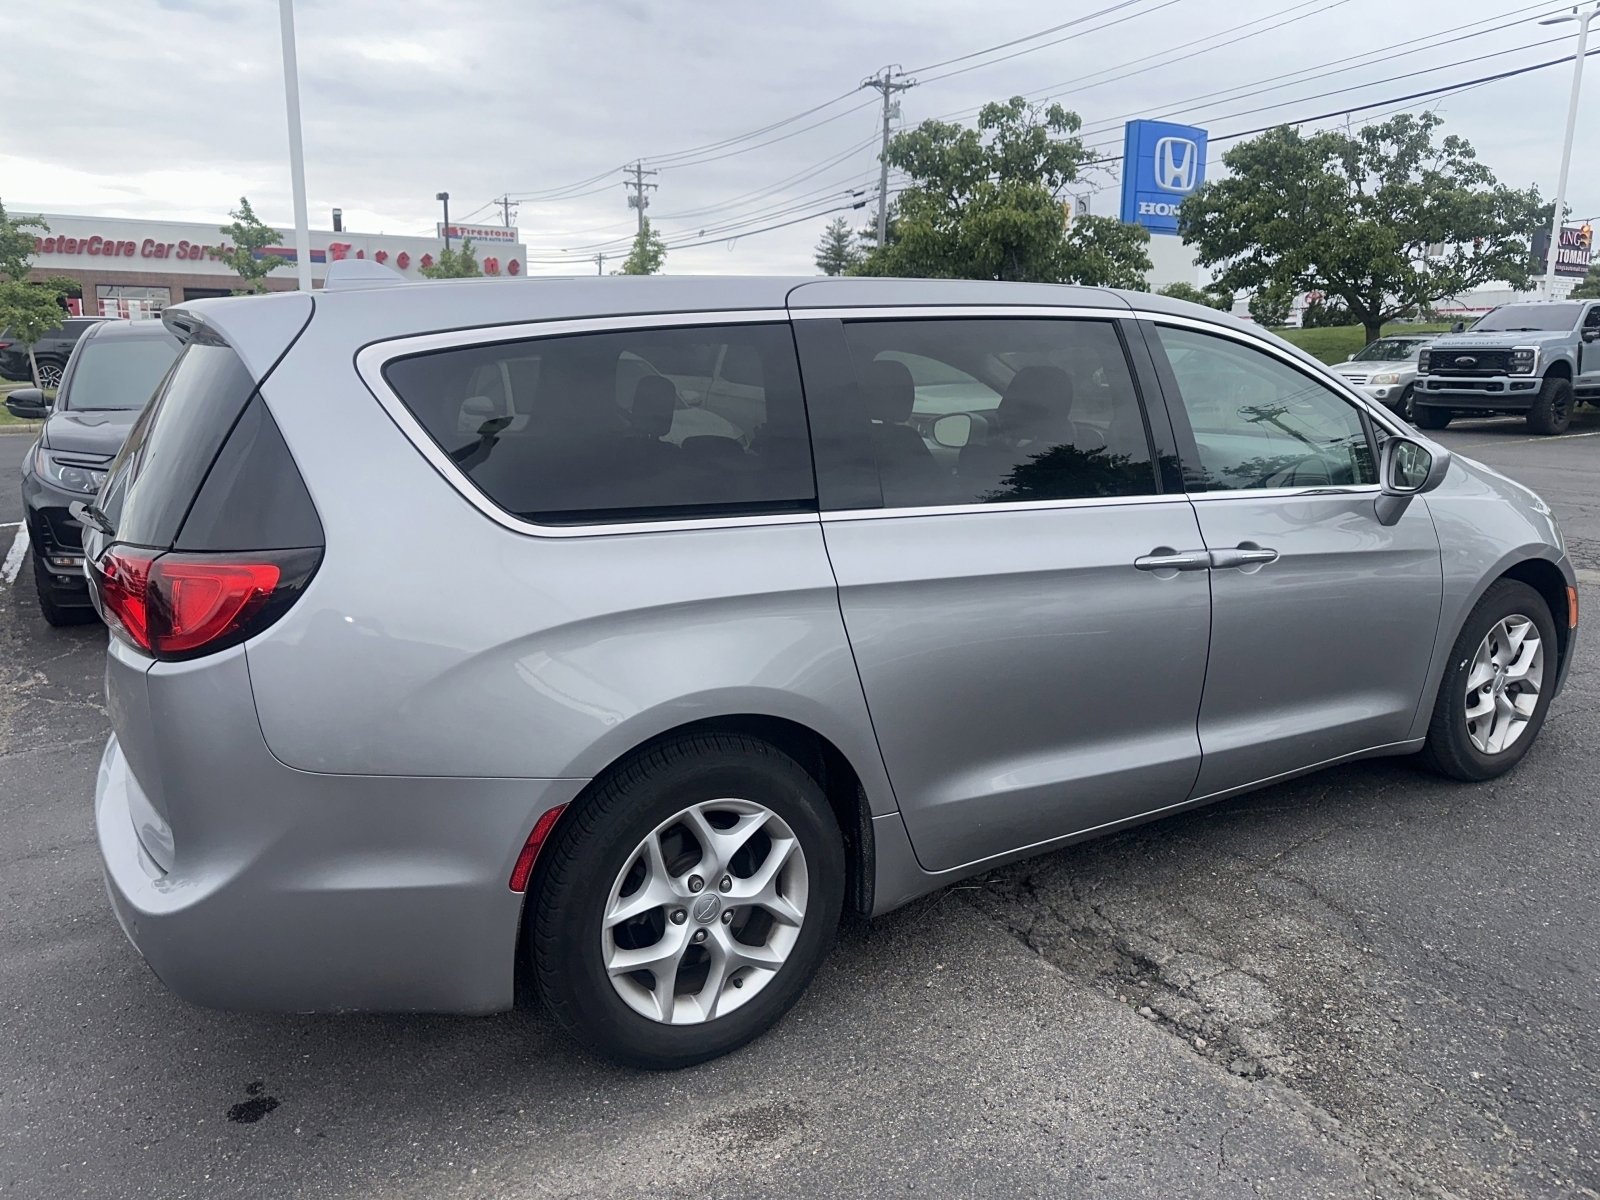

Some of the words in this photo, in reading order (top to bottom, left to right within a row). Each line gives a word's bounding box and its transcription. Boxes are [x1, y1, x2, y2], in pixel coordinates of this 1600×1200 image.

[1138, 201, 1181, 217] HON
[459, 227, 515, 238] Firestone
[1557, 231, 1584, 249] ING
[34, 235, 137, 257] asterCare
[141, 238, 175, 259] Car
[329, 242, 519, 276] Firesne
[1545, 248, 1590, 265] TOMALL
